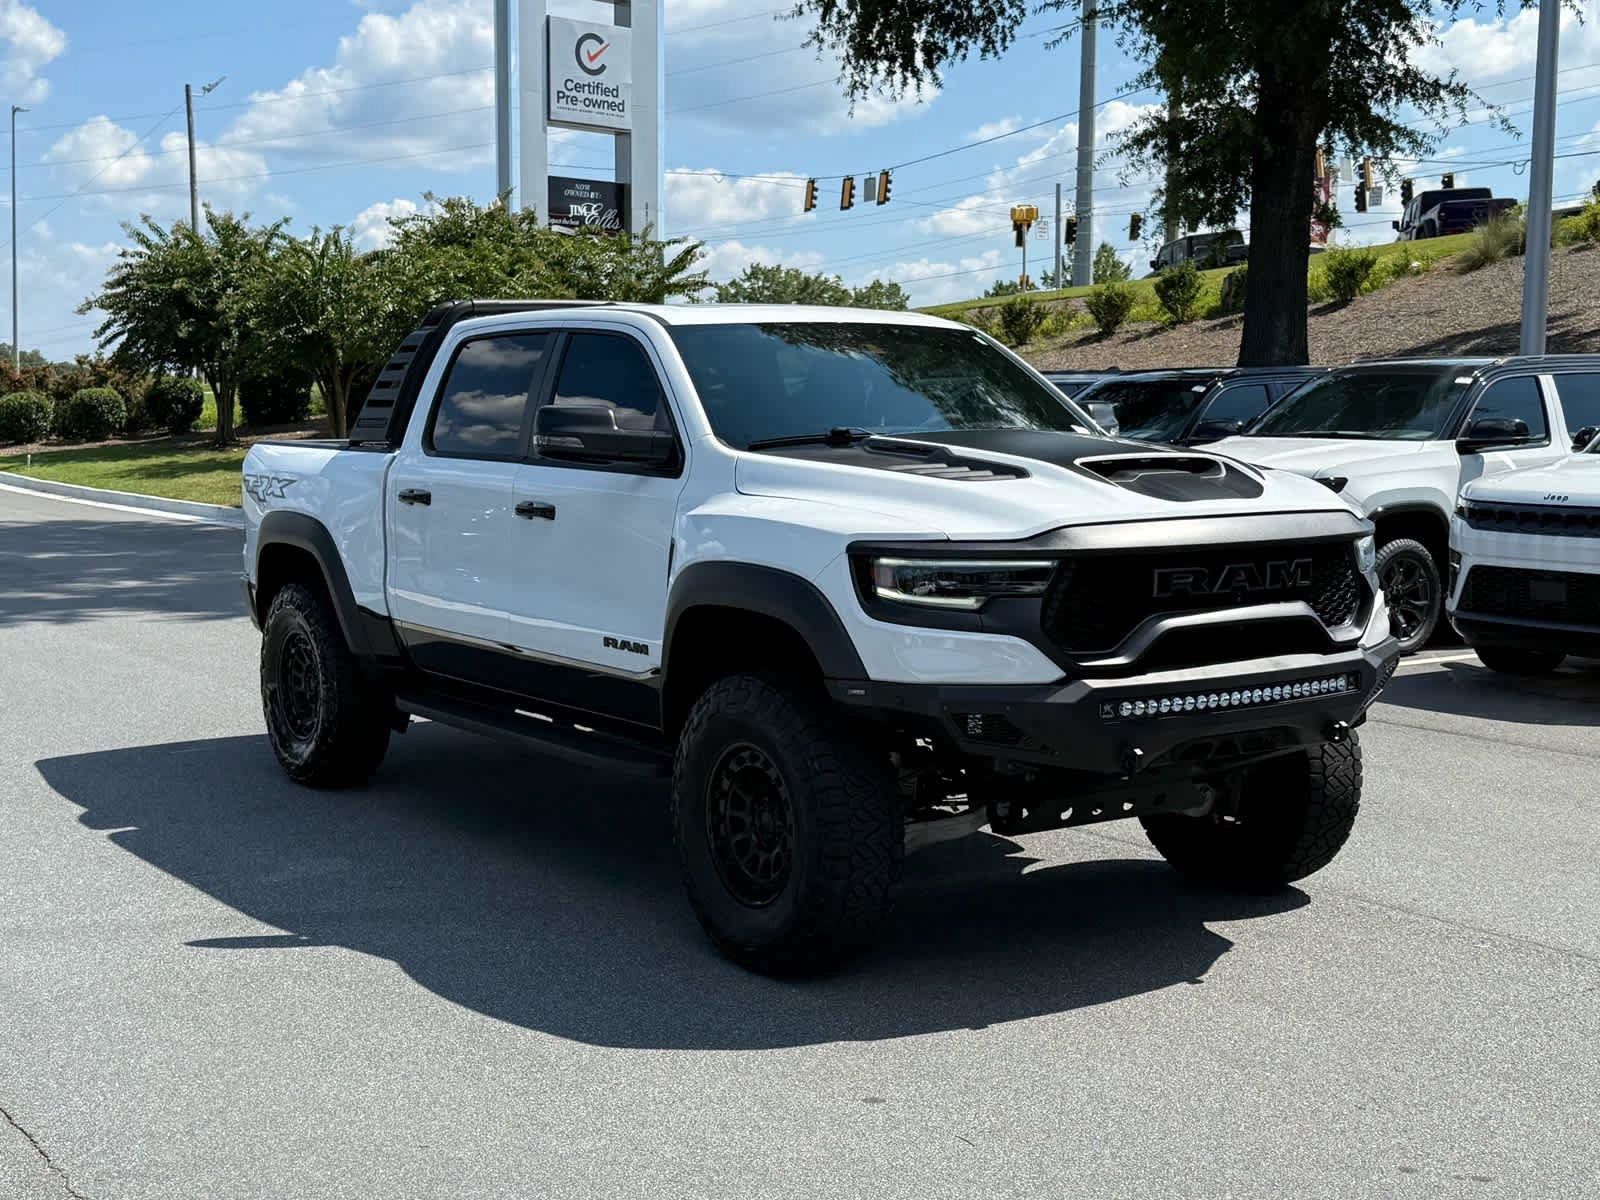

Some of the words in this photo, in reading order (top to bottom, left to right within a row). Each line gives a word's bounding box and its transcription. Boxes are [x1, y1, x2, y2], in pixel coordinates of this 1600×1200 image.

[564, 79, 619, 98] Certified
[556, 91, 625, 113] Pre-owned
[568, 204, 588, 217] JIM
[1543, 493, 1569, 503] Jeep
[1152, 558, 1313, 598] RAM
[603, 636, 649, 656] RAM
